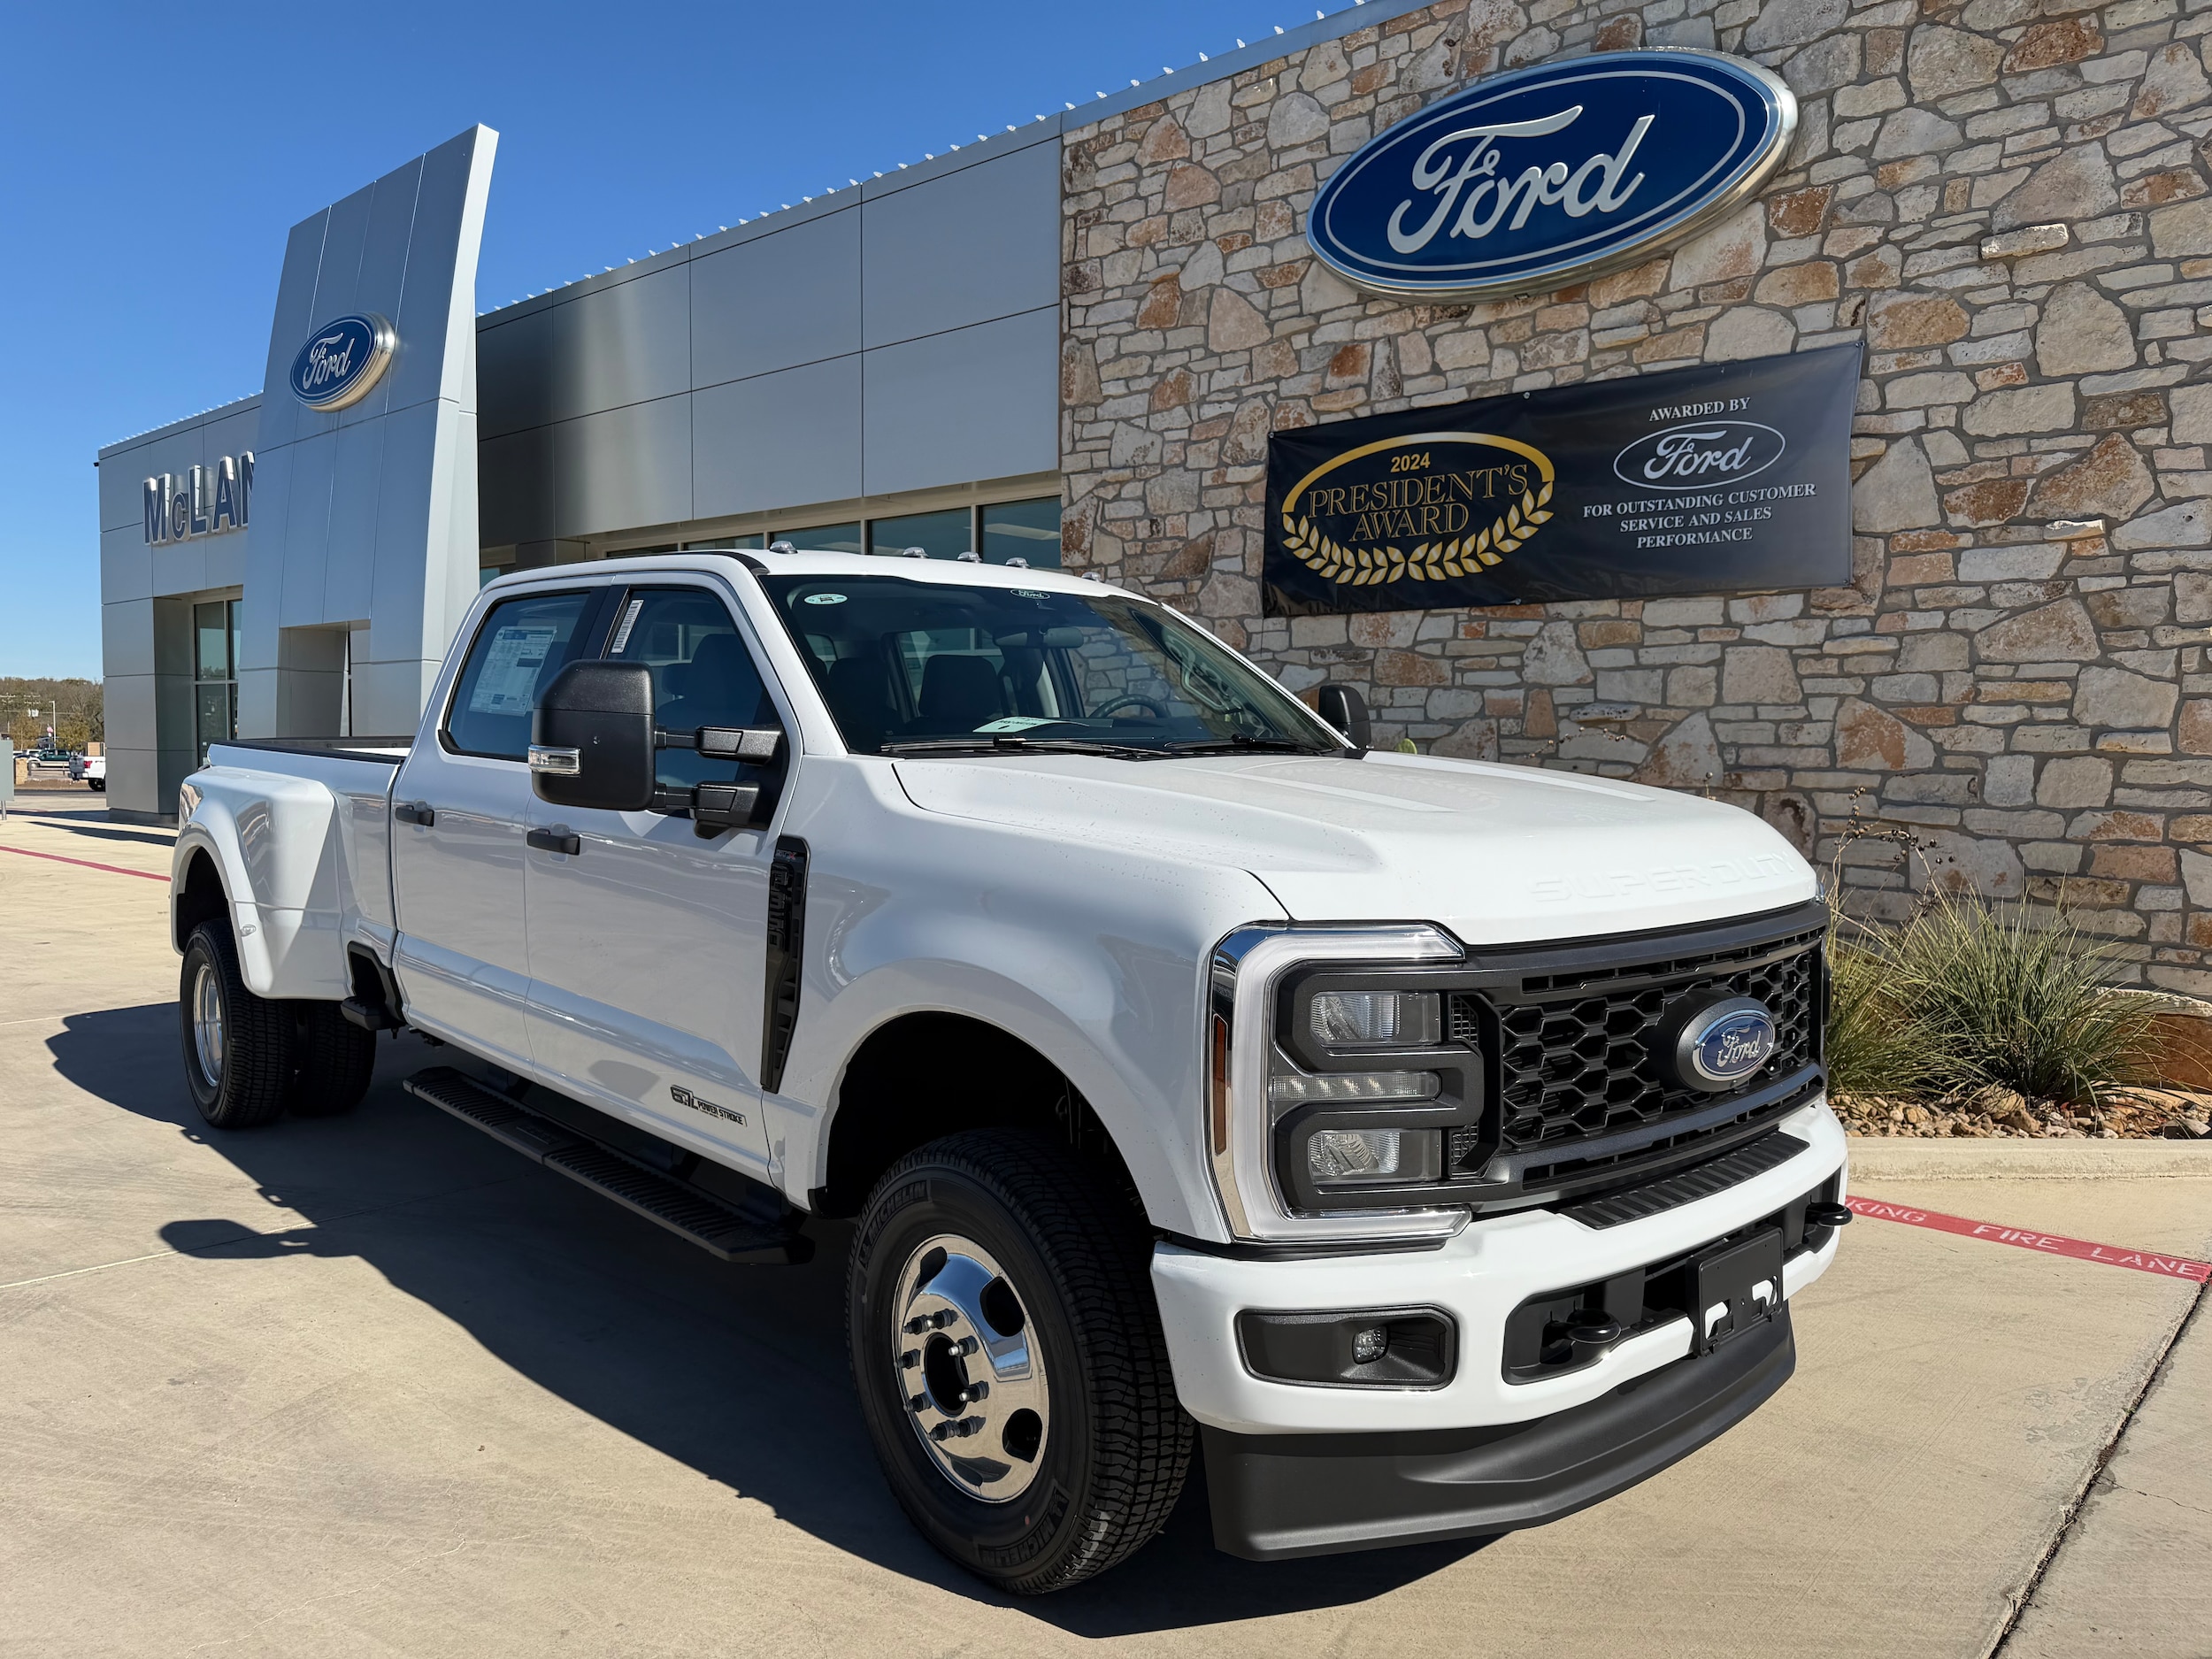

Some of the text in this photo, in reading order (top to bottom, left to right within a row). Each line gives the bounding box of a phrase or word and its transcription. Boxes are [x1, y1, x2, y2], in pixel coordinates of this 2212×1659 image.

[1386, 104, 1655, 255] Ford
[303, 332, 356, 390] Ford
[1649, 396, 1751, 421] AWARDED BY
[1390, 451, 1431, 472] 2024
[1643, 430, 1754, 480] Ford
[1307, 464, 1529, 518] PRESIDENT'S
[1583, 483, 1816, 518] FOR OUTSTANDING CUSTOMER
[1348, 503, 1470, 542] AWARD
[1620, 507, 1772, 533] SERVICE AND SALES
[1637, 527, 1753, 549] PERFORMANCE
[1530, 851, 1795, 902] SUPER DUTY
[1717, 1025, 1761, 1067] Ford
[697, 1100, 719, 1116] POWER
[718, 1109, 743, 1125] STROKE
[1972, 1224, 2065, 1250] FIRE
[2091, 1247, 2207, 1278] LANE
